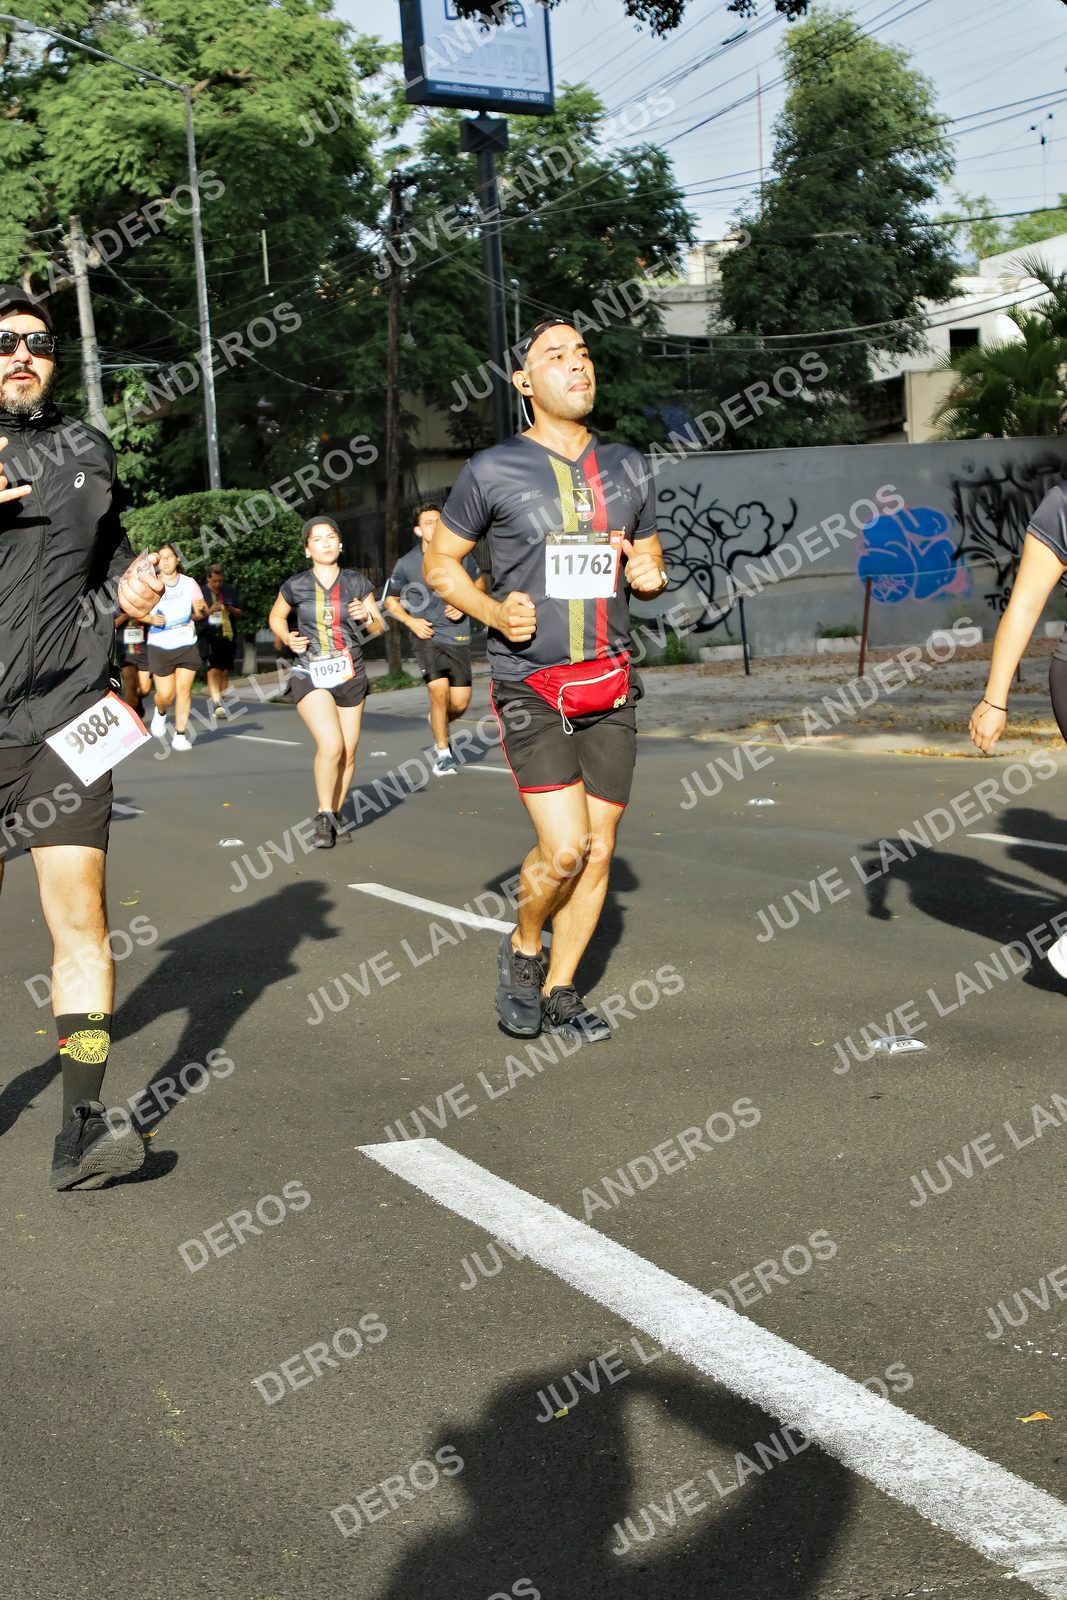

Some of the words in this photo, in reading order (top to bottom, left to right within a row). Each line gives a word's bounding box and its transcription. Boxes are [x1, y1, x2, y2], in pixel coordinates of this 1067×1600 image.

[551, 553, 612, 575] 11762
[314, 660, 347, 677] 10927
[64, 705, 120, 755] 9884
